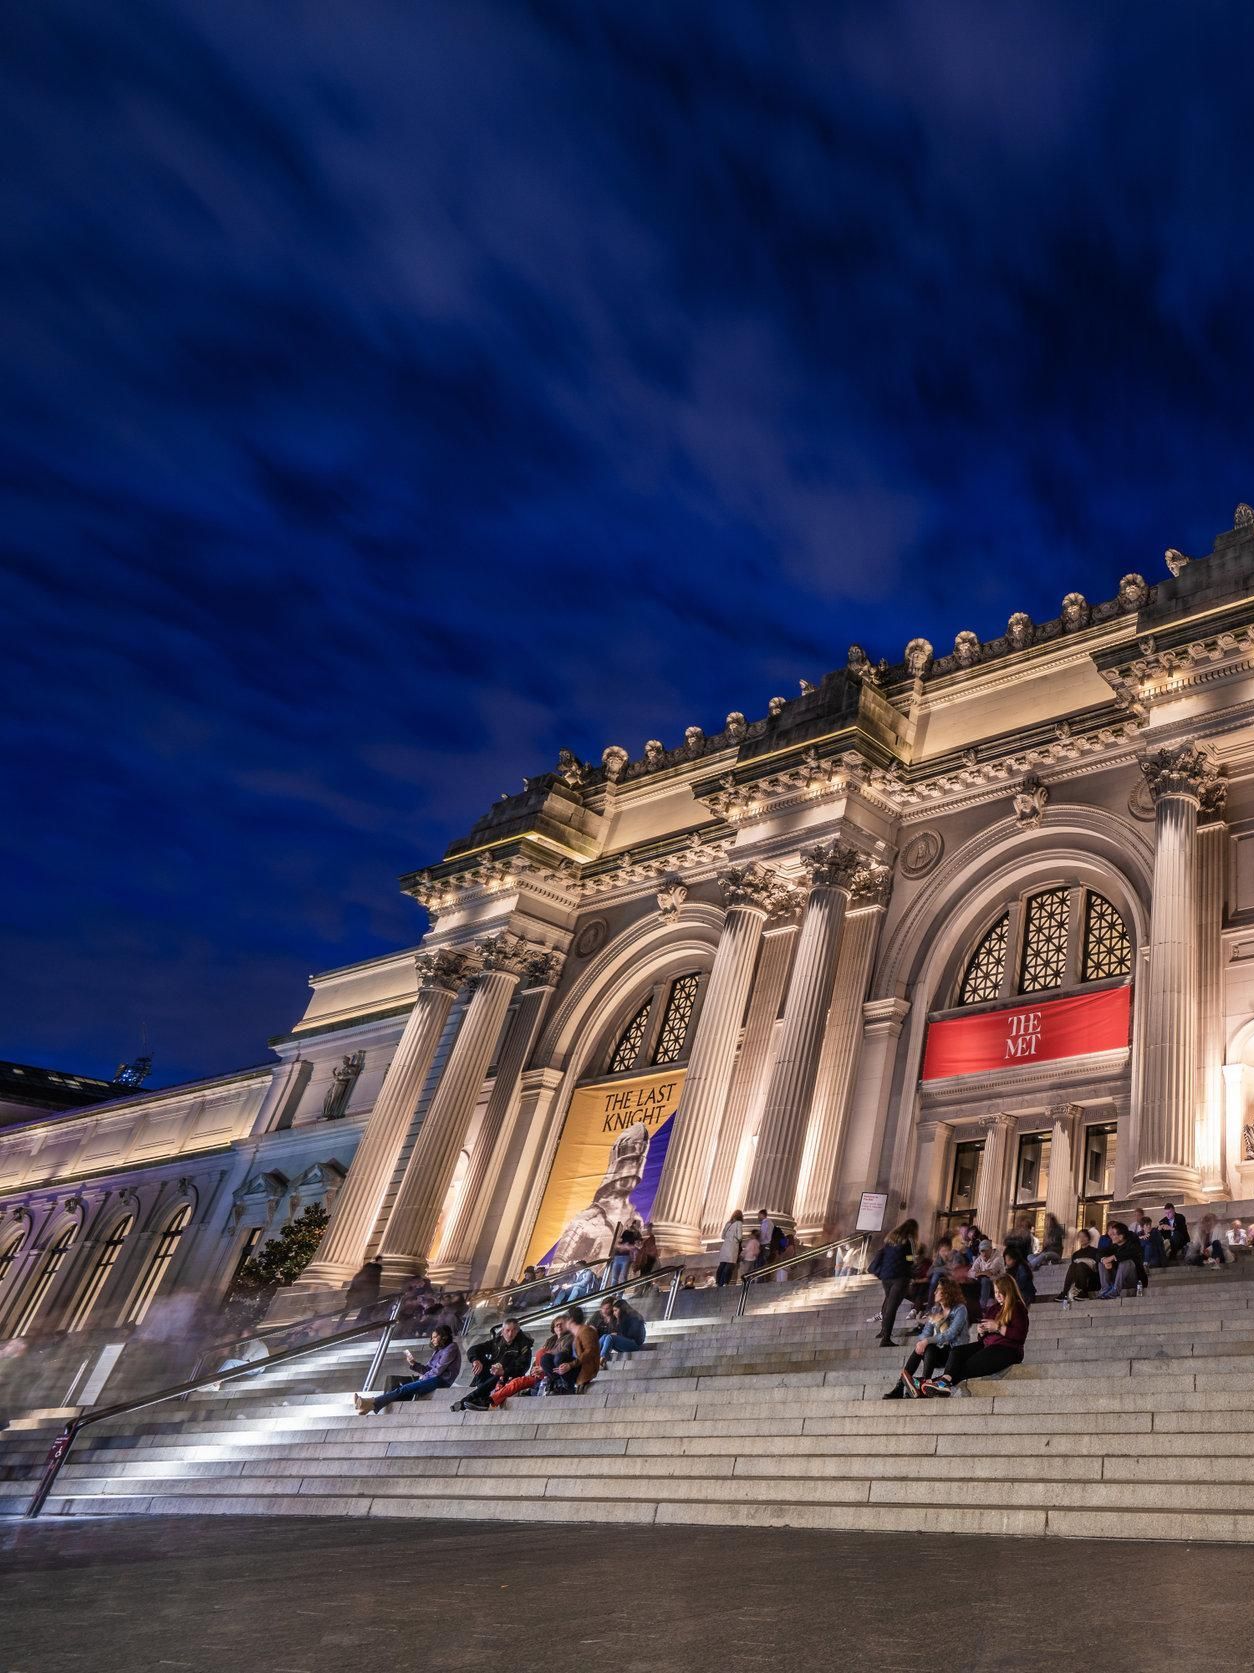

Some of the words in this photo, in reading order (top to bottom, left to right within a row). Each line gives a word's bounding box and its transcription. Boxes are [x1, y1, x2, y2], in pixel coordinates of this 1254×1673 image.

[1008, 1012, 1042, 1037] THE
[1004, 1033, 1042, 1059] MET
[605, 1091, 633, 1112] THE
[636, 1083, 677, 1107] LAST
[602, 1105, 666, 1132] KNIGHT
